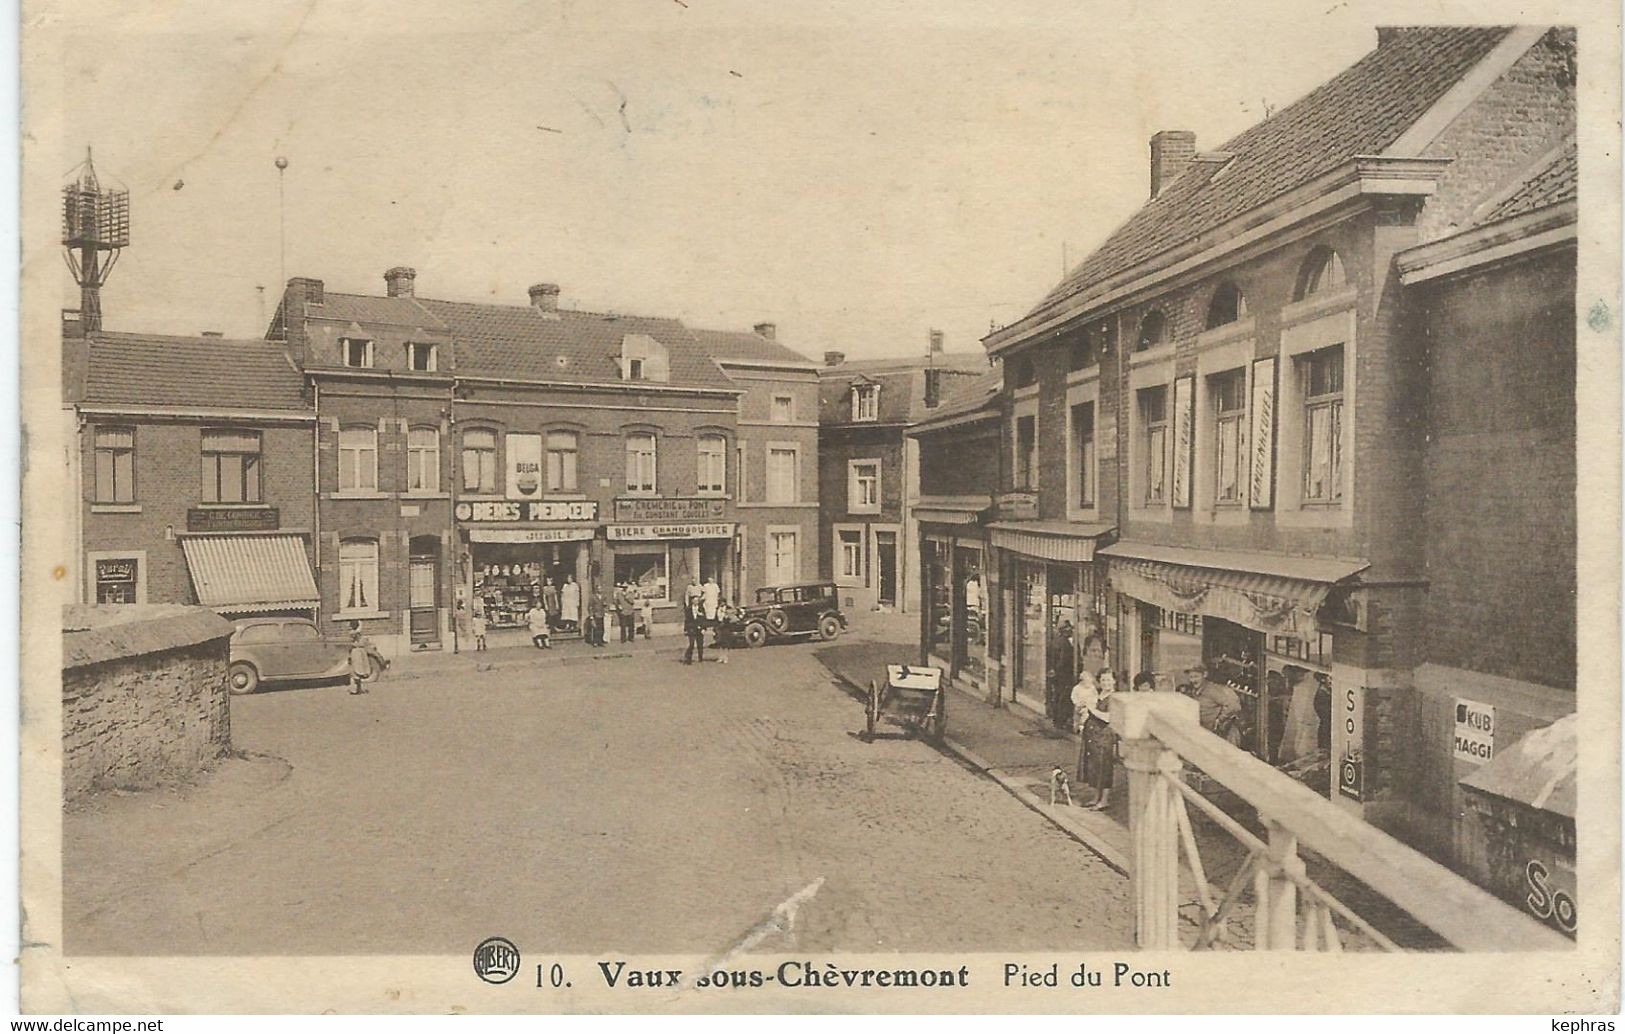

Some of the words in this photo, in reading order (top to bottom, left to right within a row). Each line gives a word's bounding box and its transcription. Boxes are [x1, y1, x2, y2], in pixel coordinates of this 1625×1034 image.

[516, 463, 539, 473] BELGA
[1467, 709, 1493, 732] KUB
[1344, 689, 1356, 785] SOLO
[1454, 735, 1492, 760] MAGGI
